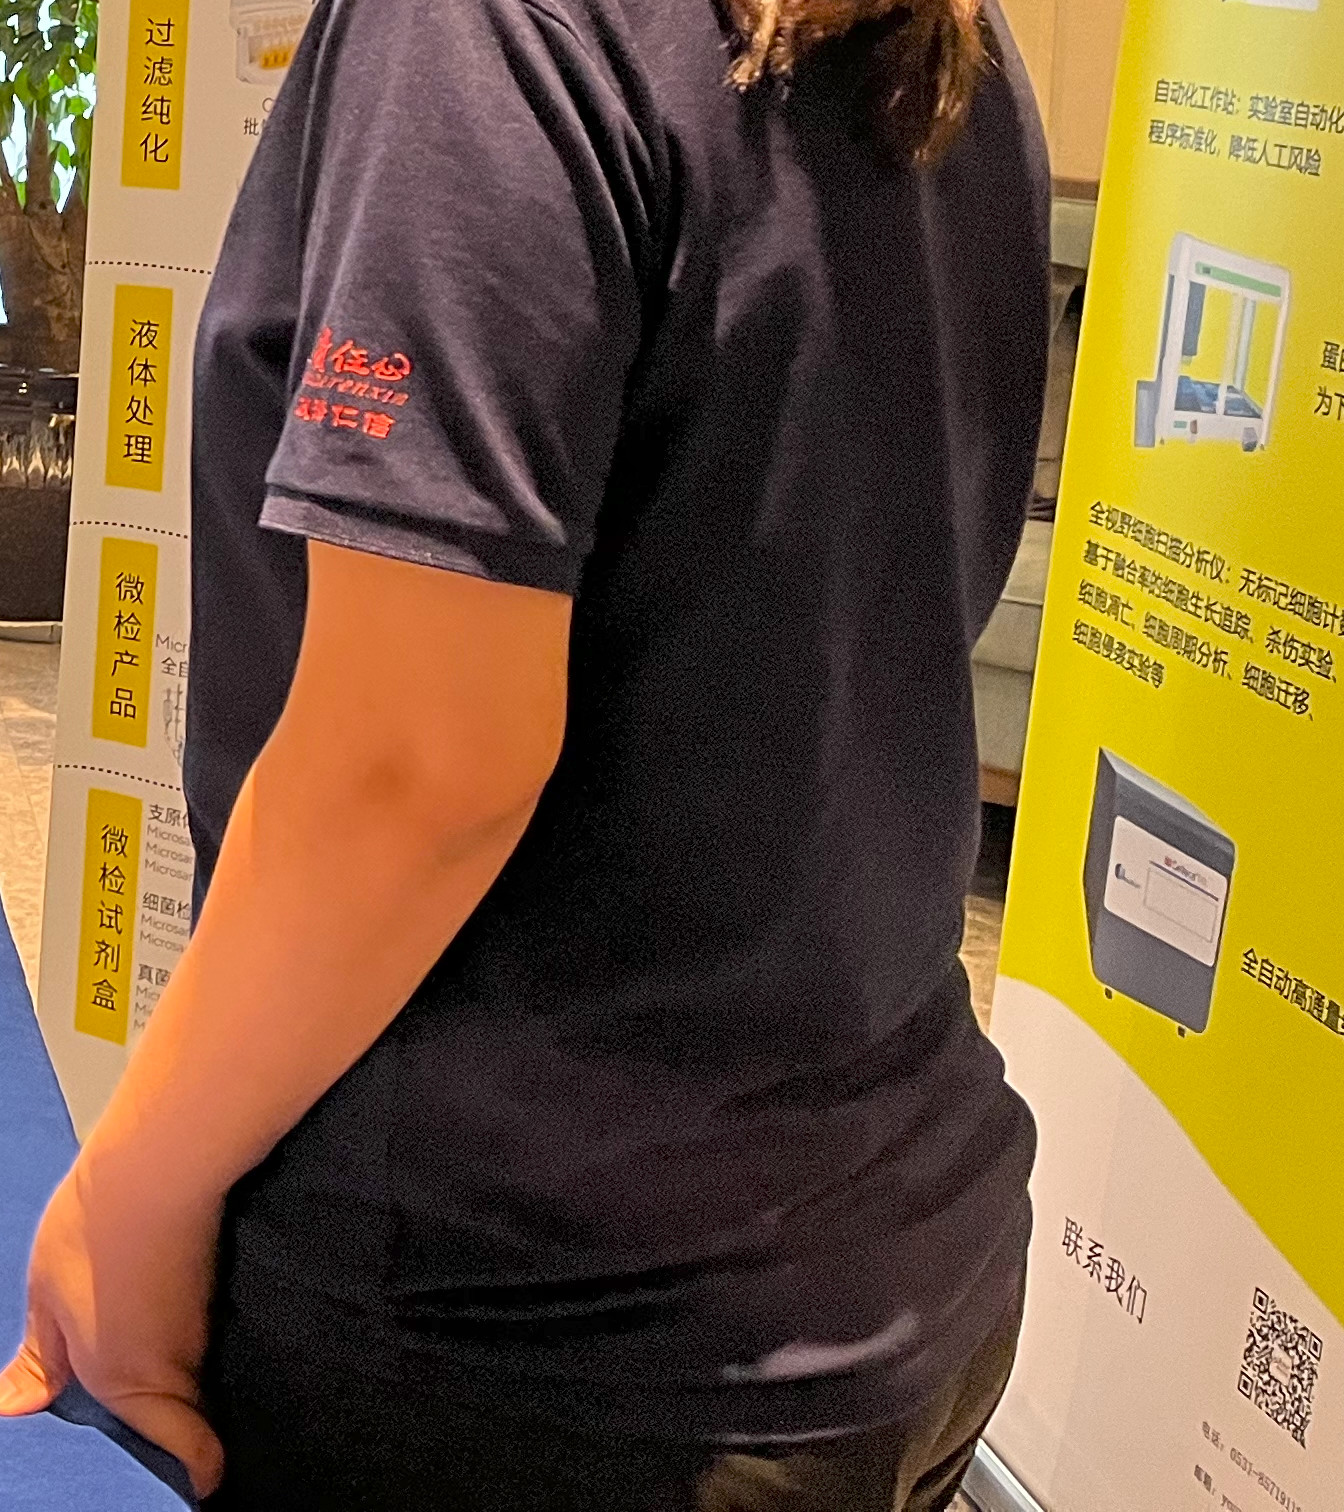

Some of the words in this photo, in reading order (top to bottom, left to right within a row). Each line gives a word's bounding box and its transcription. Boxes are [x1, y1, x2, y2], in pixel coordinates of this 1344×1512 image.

[139, 17, 176, 164] 过滤纯化
[122, 319, 161, 466] 液体处理
[108, 571, 146, 721] 微检产品
[90, 824, 129, 1013] 微检试剂盒
[1241, 948, 1344, 1035] 全自动高通量
[1062, 1216, 1149, 1325] 联系我们
